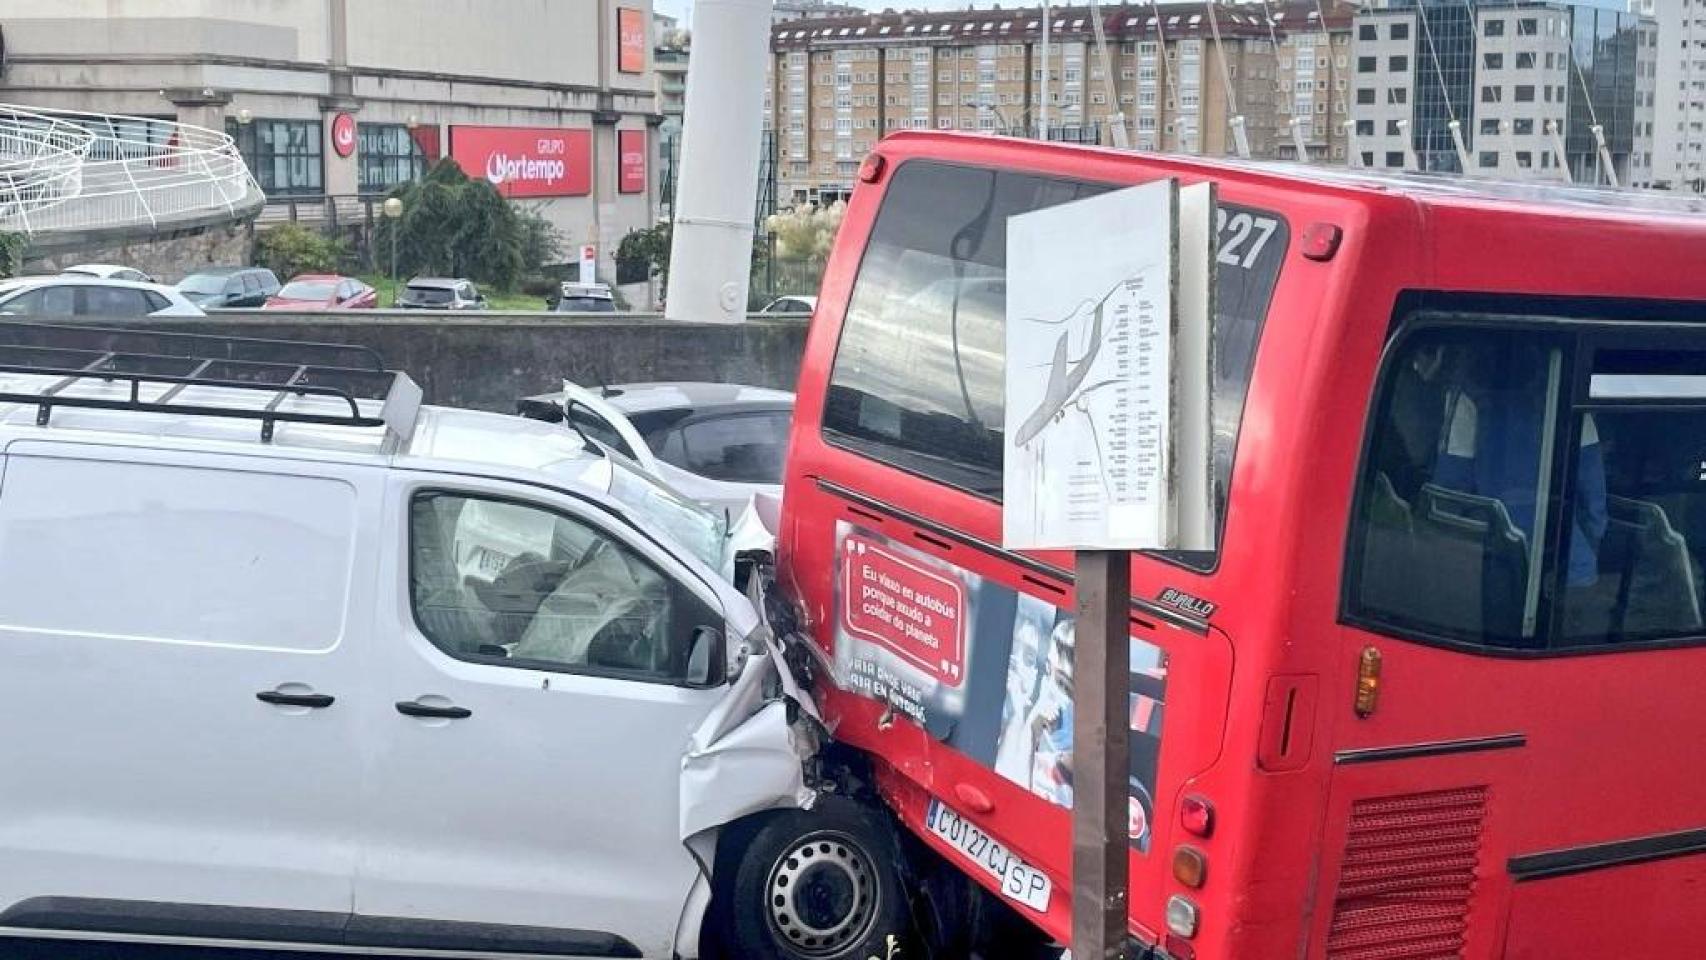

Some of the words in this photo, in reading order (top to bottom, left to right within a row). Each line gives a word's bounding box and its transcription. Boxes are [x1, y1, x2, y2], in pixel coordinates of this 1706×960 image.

[537, 139, 564, 154] GRUPO
[491, 153, 564, 185] Nortempo
[862, 565, 877, 581] Eu
[902, 586, 914, 601] en
[915, 592, 956, 619] autobús
[862, 585, 896, 609] porque
[924, 614, 932, 627] a
[905, 623, 939, 649] planeta
